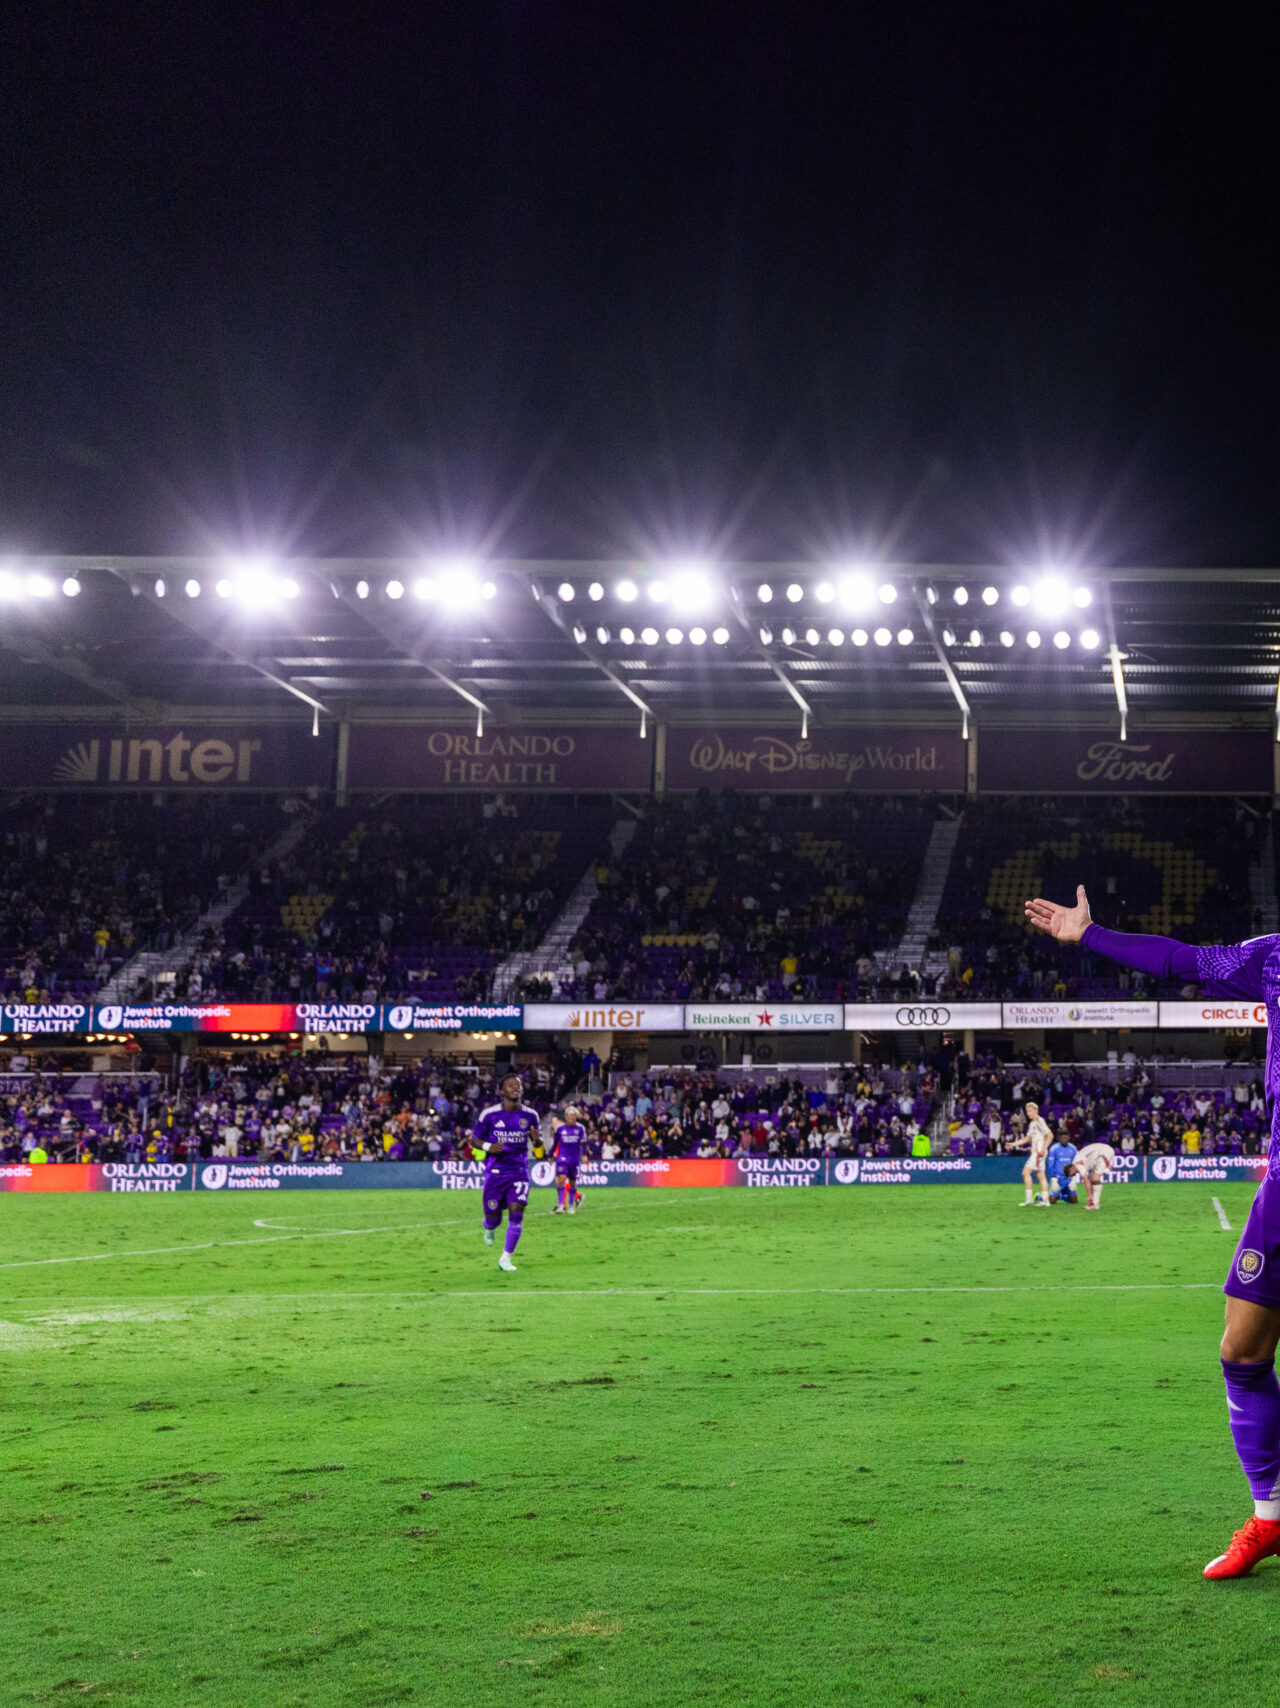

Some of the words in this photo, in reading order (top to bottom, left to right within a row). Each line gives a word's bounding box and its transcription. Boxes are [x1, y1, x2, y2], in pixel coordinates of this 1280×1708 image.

[427, 732, 575, 756] ORLANDO
[865, 747, 936, 771] World
[1077, 742, 1176, 781] Ford
[444, 759, 556, 783] HEALTH
[5, 1004, 86, 1019] ORLANDO
[123, 1005, 164, 1018] Jewett
[164, 1005, 231, 1019] Orthopedic
[296, 1003, 376, 1018] ORLANDO
[413, 1005, 453, 1018] Jewett
[454, 1005, 521, 1019] Orthopedic
[1009, 1006, 1059, 1016] ORLANDO
[1083, 1007, 1109, 1015] Jewett
[1109, 1007, 1151, 1016] Orthopedic
[1083, 1013, 1115, 1022] Institute
[1201, 1008, 1249, 1020] CIRCLE
[13, 1018, 75, 1033] HEALTH
[122, 1018, 172, 1030] Institute
[304, 1018, 366, 1033] HEALTH
[413, 1017, 462, 1029] Institute
[692, 1012, 751, 1025] Heineken
[779, 1013, 836, 1025] SILVER
[1015, 1014, 1054, 1024] HEALTH
[433, 1160, 486, 1175] ORLAN
[600, 1160, 670, 1174] Orthopedic
[738, 1158, 821, 1173] ORLANDO
[860, 1159, 901, 1171] Jewett
[903, 1159, 972, 1173] Orthopedic
[1178, 1156, 1218, 1168] Jewett
[1219, 1156, 1269, 1170] Orthope
[102, 1163, 187, 1178] ORLANDO
[228, 1164, 271, 1176] Jewett
[272, 1164, 343, 1178] Orthopedic
[860, 1171, 911, 1183] Institute
[1178, 1168, 1227, 1179] Institute
[112, 1178, 177, 1192] HEALTH
[228, 1176, 280, 1189] Institute
[747, 1173, 810, 1187] HEALTH
